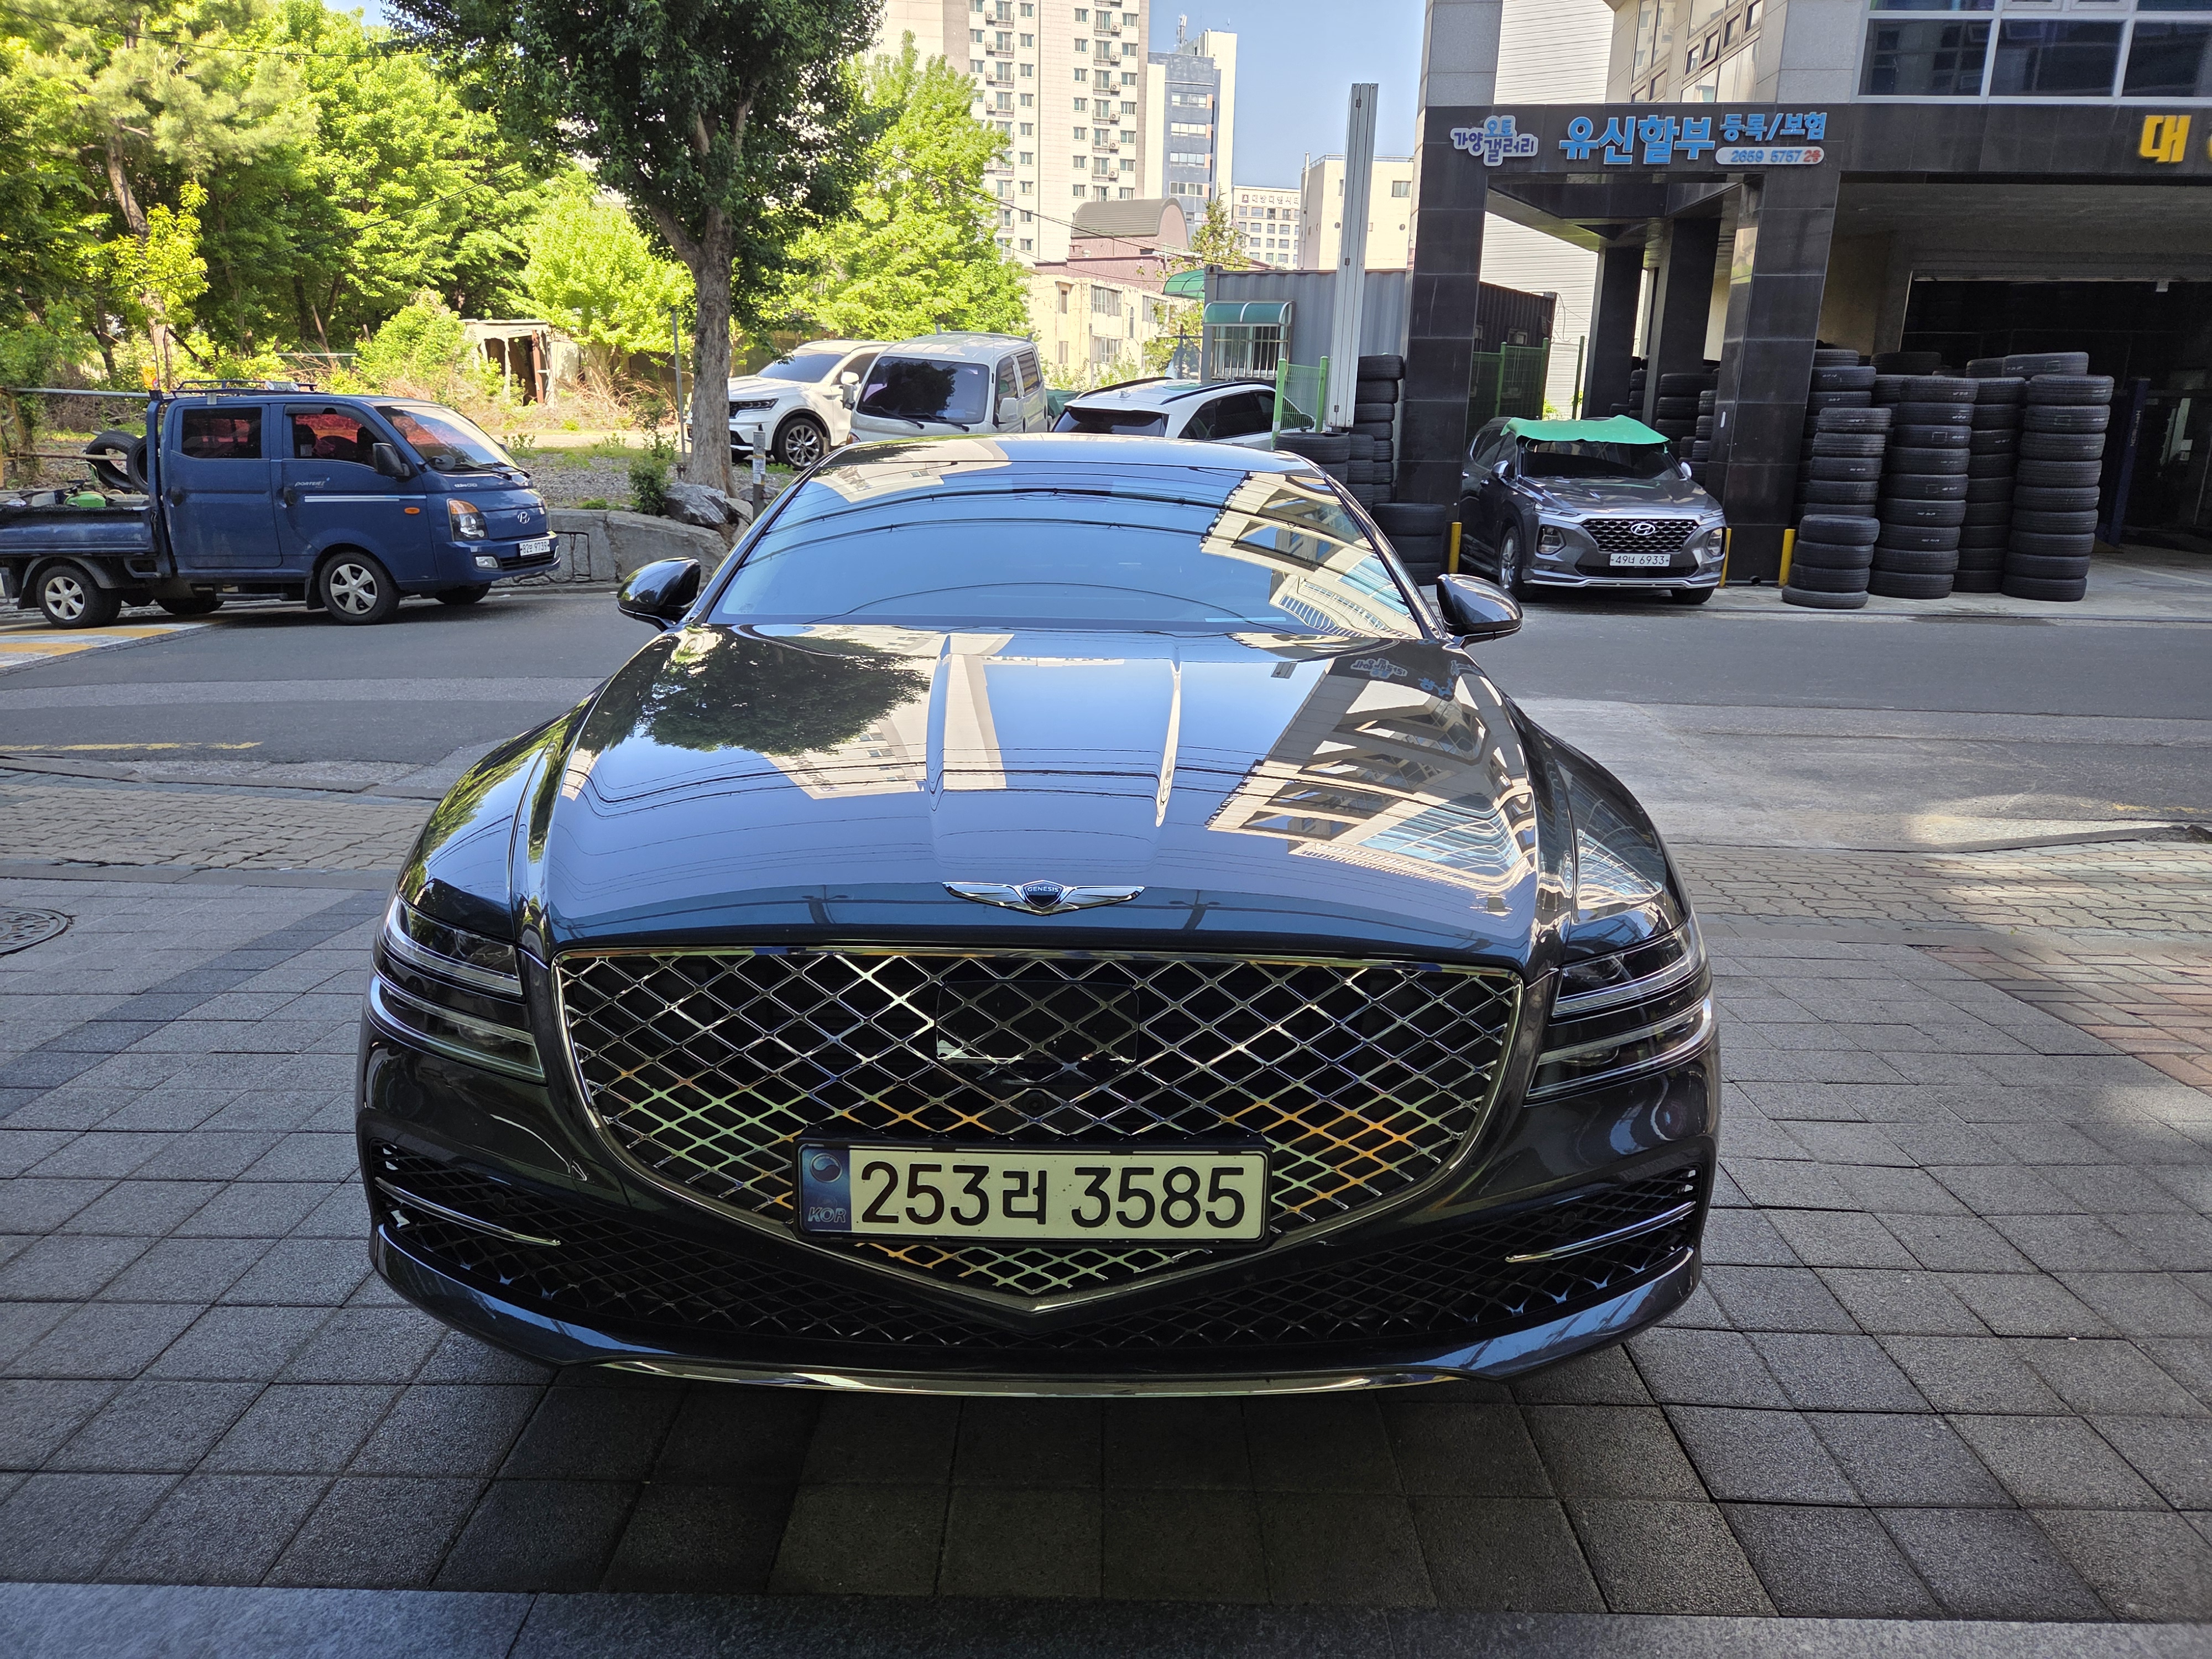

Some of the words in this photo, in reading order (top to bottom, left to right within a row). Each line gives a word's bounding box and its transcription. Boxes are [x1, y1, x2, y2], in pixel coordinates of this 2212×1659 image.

[1485, 119, 1512, 137] 오토
[1720, 112, 1827, 142] 등록/보험
[1454, 132, 1483, 152] 가양
[1559, 115, 1715, 164] 유신할부
[1484, 138, 1534, 163] 갤러리
[1730, 149, 1764, 163] 2659
[1771, 149, 1803, 163] 5757
[534, 541, 547, 552] 9739
[1615, 555, 1635, 564] 49너
[1639, 555, 1665, 565] 6933
[861, 1161, 1047, 1226] 253러
[1071, 1166, 1245, 1228] 3585
[807, 1207, 846, 1223] KOR
